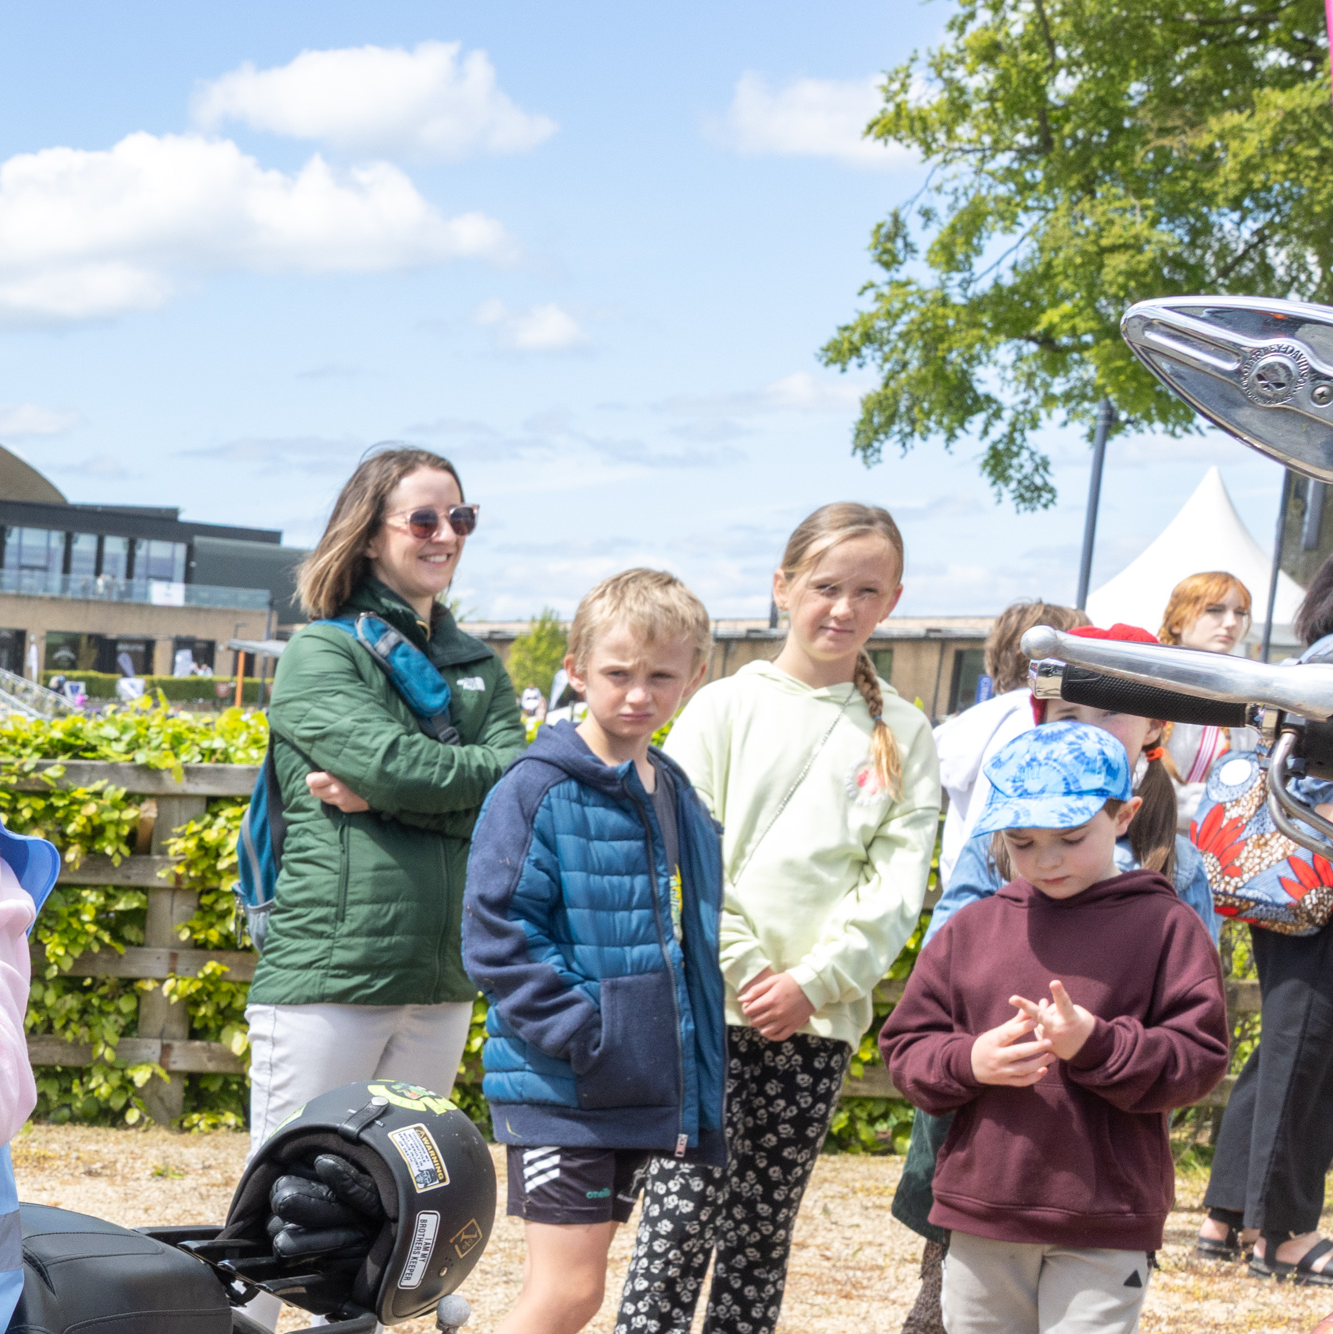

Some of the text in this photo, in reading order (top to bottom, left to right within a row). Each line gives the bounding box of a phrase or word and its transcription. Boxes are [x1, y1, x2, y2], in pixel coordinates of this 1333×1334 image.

[421, 1134, 444, 1181] WARNING
[403, 1218, 428, 1281] BROTHERS KEEPER
[418, 1253, 428, 1263] MY
[422, 1241, 431, 1252] AM
